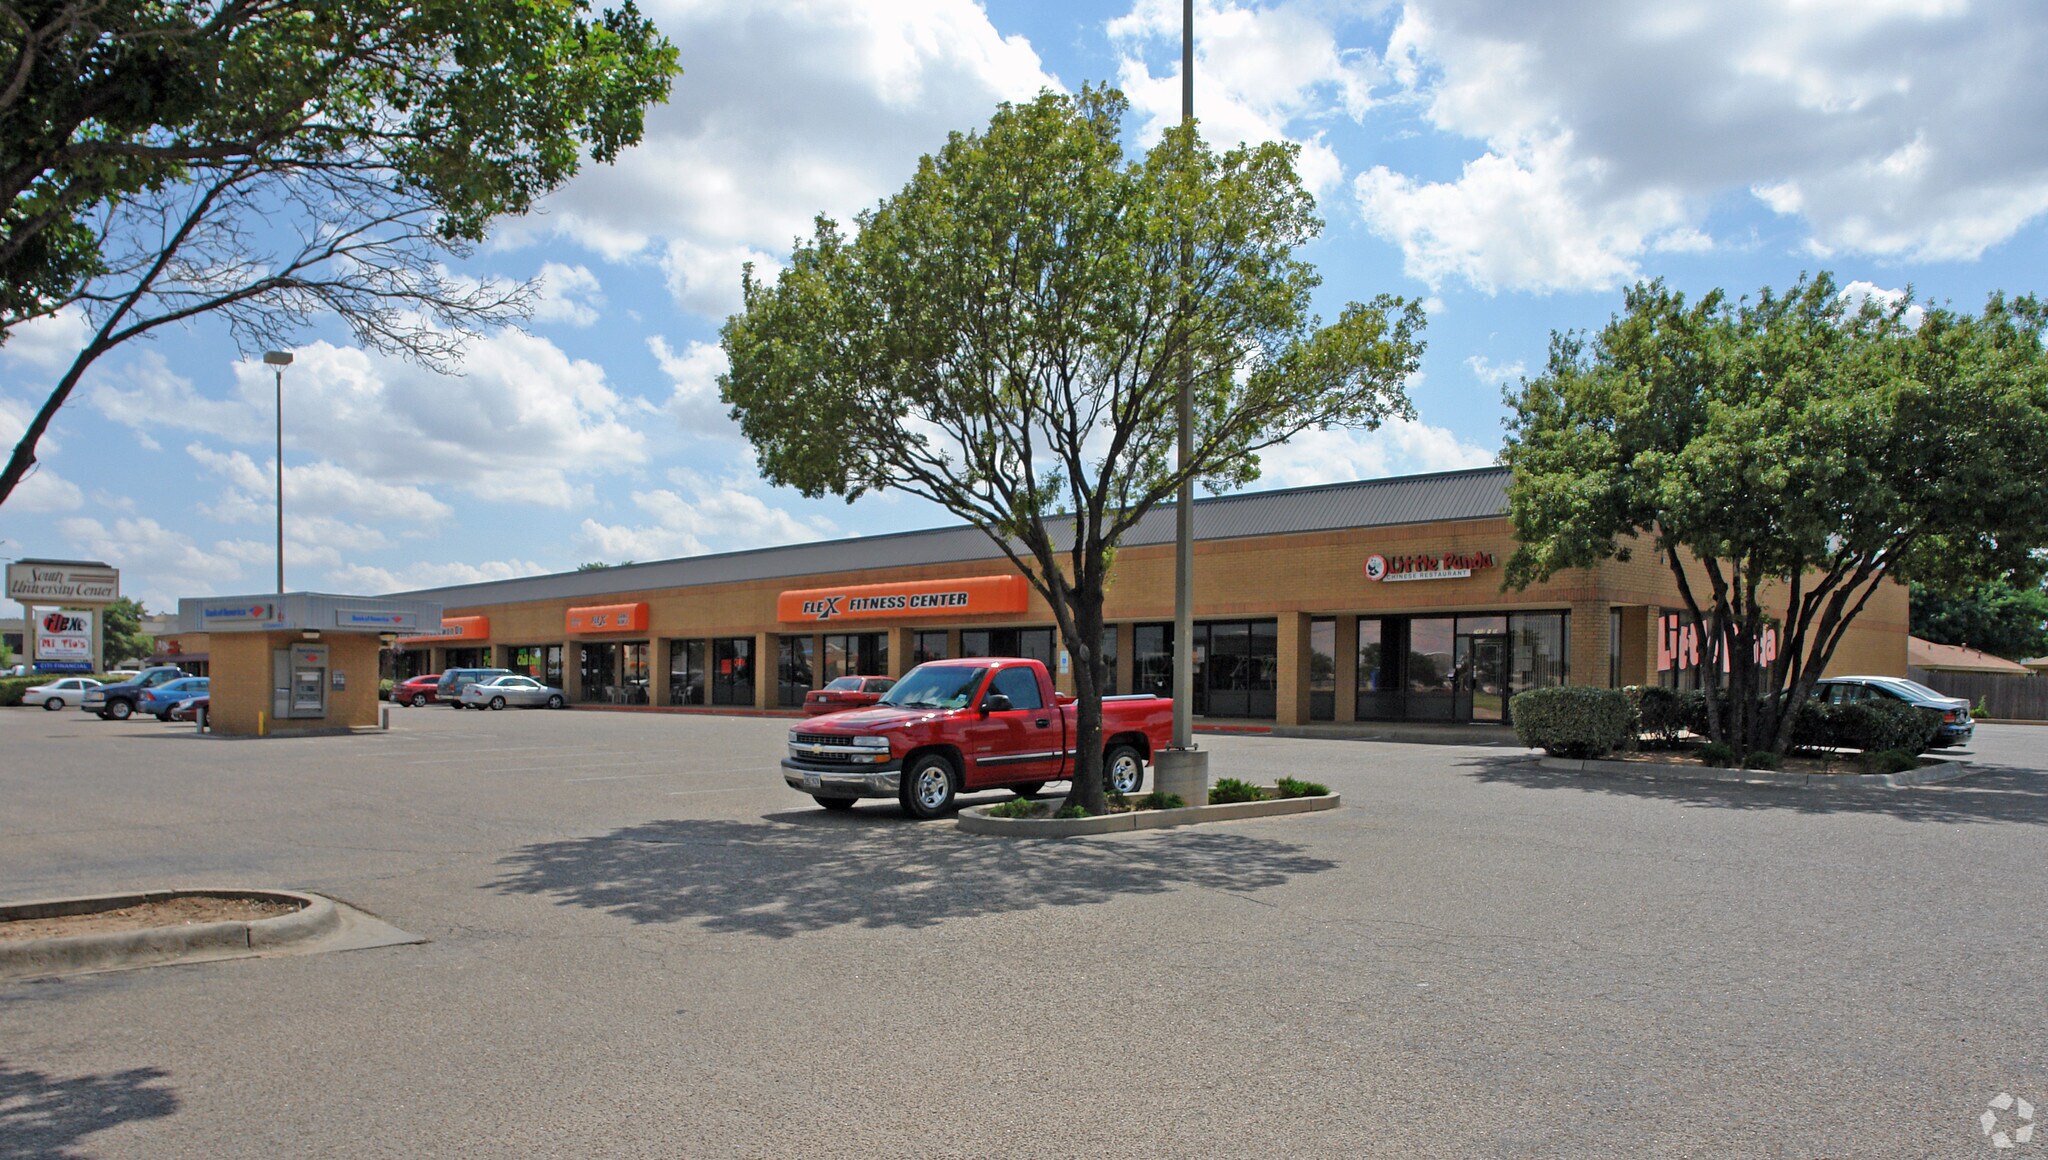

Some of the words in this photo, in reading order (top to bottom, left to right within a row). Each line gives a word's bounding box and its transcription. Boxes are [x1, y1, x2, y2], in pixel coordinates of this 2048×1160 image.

[1387, 554, 1438, 574] Little
[1442, 550, 1493, 570] Panda
[30, 567, 63, 583] South
[1419, 569, 1467, 578] RESTAURANT
[12, 580, 74, 597] University
[76, 582, 114, 597] Center
[224, 608, 246, 616] America
[803, 596, 844, 619] FLEX
[849, 595, 906, 611] FITNESS
[909, 592, 968, 608] CENTER
[42, 639, 55, 648] Mi
